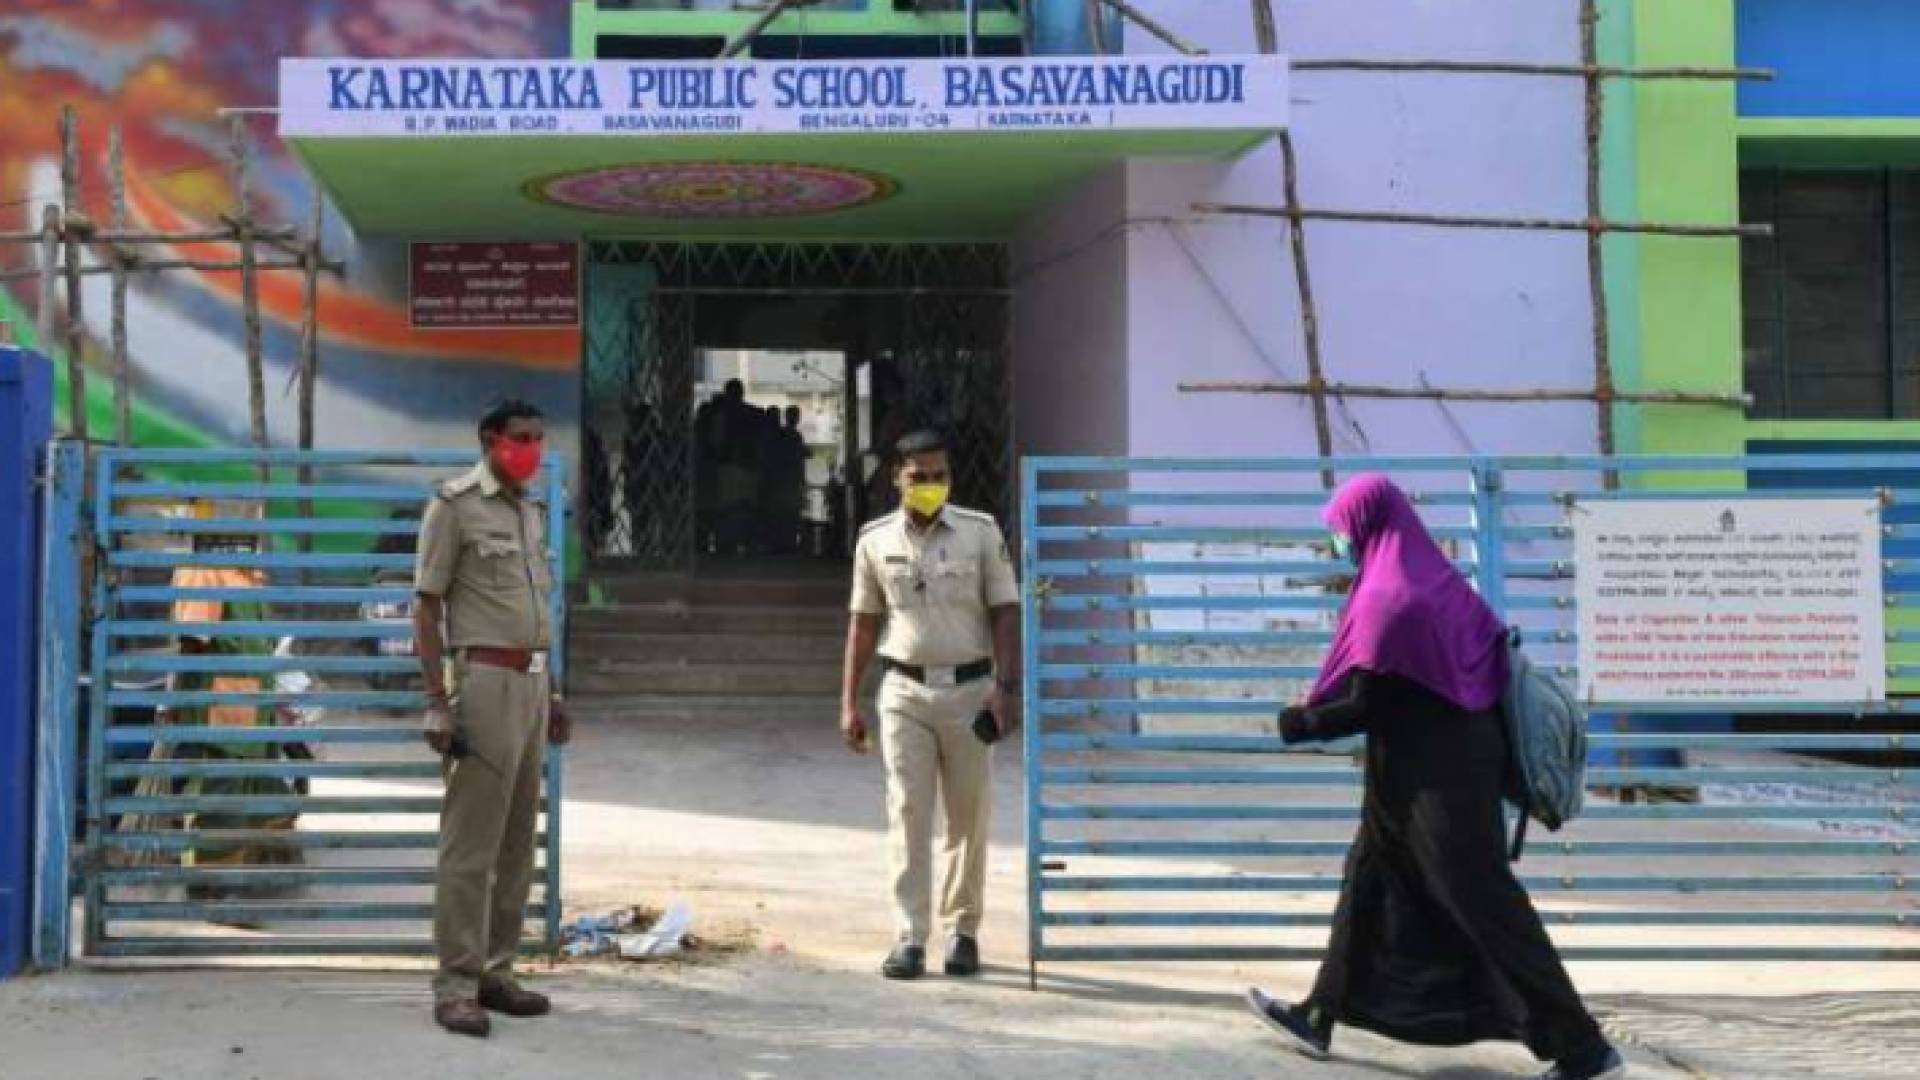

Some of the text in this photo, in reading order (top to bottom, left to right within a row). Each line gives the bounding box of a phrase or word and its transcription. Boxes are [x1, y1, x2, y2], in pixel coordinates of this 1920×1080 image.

[328, 67, 602, 109] KARNATAKA
[629, 67, 757, 109] PUBLIC
[944, 64, 1244, 109] BASAVANAGUDI
